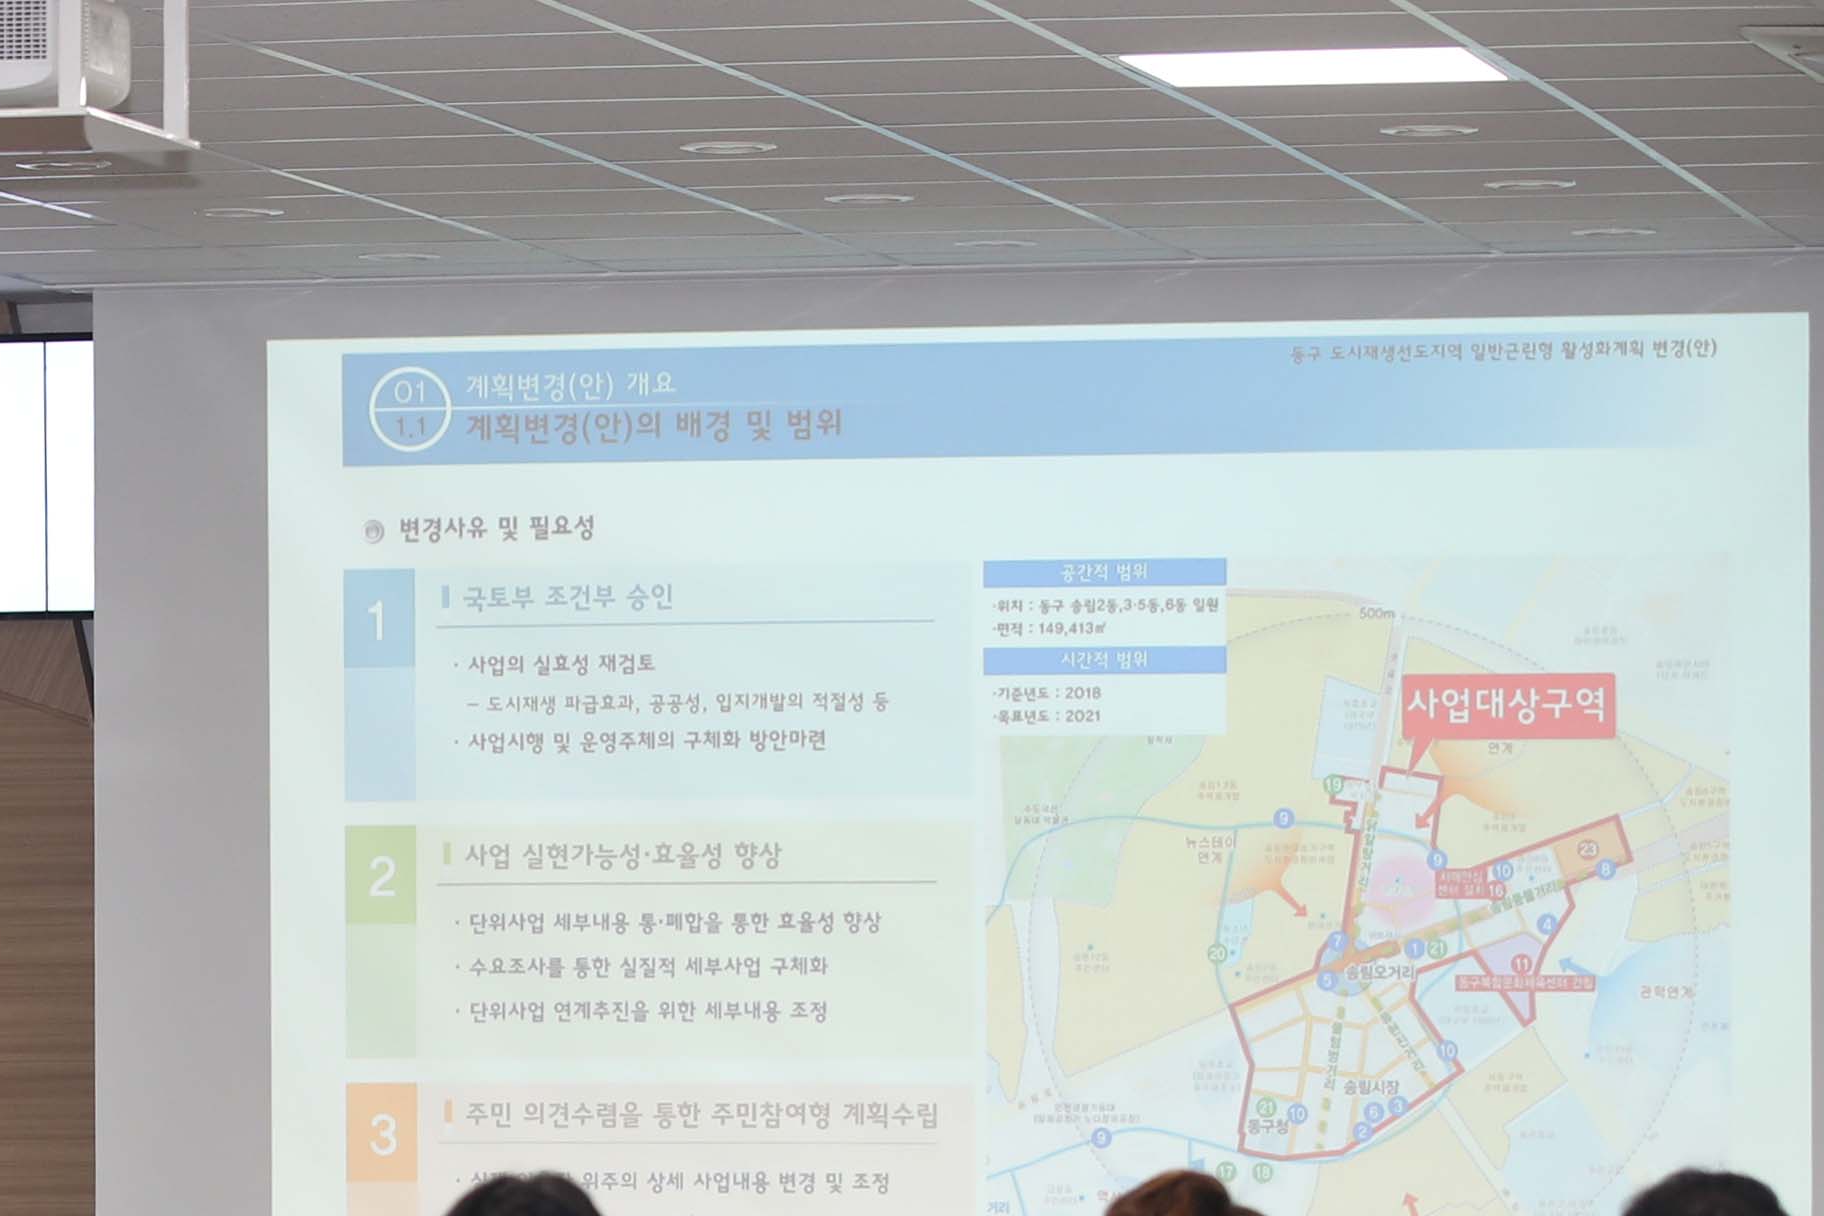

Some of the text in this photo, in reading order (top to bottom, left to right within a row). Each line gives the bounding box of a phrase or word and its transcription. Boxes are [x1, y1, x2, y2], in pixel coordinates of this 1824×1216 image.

[1290, 337, 1717, 364] 동구 도시재생선도지역 일반근린형 활성화계획 변경(안)
[393, 380, 427, 404] 01
[467, 372, 675, 402] 계획변경(안) 개요
[395, 415, 427, 440] 1.1
[465, 407, 843, 445] 계획변경(안)의 배경 및 범위
[401, 515, 593, 543] 변경사유 및 필요성
[1061, 563, 1149, 583] 공간적 범위
[463, 584, 672, 612] 국토부 조건부 승인
[1039, 599, 1064, 614] 동구
[1193, 598, 1219, 613] 일원
[367, 600, 384, 640] 1
[1360, 607, 1396, 619] 500m
[469, 654, 655, 676] 사업의 실효성 재검토
[1062, 650, 1149, 669] 시간적 범위
[488, 692, 888, 715] 도시재생 파급효과, 공공성, 입지개발의 적절성 등
[1065, 687, 1102, 699] 2018
[1065, 710, 1101, 722] 2021
[1407, 687, 1605, 725] 사업대상구역
[469, 730, 825, 754] 사업시행 및 운영주체의 구체화 방안마련
[1279, 812, 1289, 826] 9
[465, 842, 782, 871] 사업 실현가능성·효율성 향상
[1433, 853, 1443, 868] 9
[368, 855, 396, 897] 2
[1495, 863, 1511, 878] 10
[1601, 862, 1611, 877] 8
[470, 913, 544, 934] 단위사업
[554, 912, 629, 935] 세부내용
[732, 912, 769, 934] 통한
[778, 912, 833, 934] 효율성
[844, 912, 881, 934] 향상
[1543, 918, 1553, 931] 4
[1333, 935, 1343, 948] 7
[470, 956, 828, 979] 수요조사를 통한 실질적 세부사업 구체화
[471, 1000, 826, 1023] 단위사업 연계추진을 위한 세부내용 조정
[1344, 1080, 1399, 1096] 송림시장
[466, 1101, 937, 1130] 주민 의견수렴을 통한 주민참여형 계획수립
[1290, 1107, 1305, 1120] 10
[369, 1113, 398, 1156] 3
[1357, 1126, 1368, 1139] 2
[581, 1170, 638, 1192] 위주의
[647, 1172, 683, 1194] 상세
[694, 1171, 770, 1194] 사업내용
[779, 1173, 815, 1194] 변경
[826, 1173, 842, 1193] 및
[853, 1173, 888, 1194] 조정
